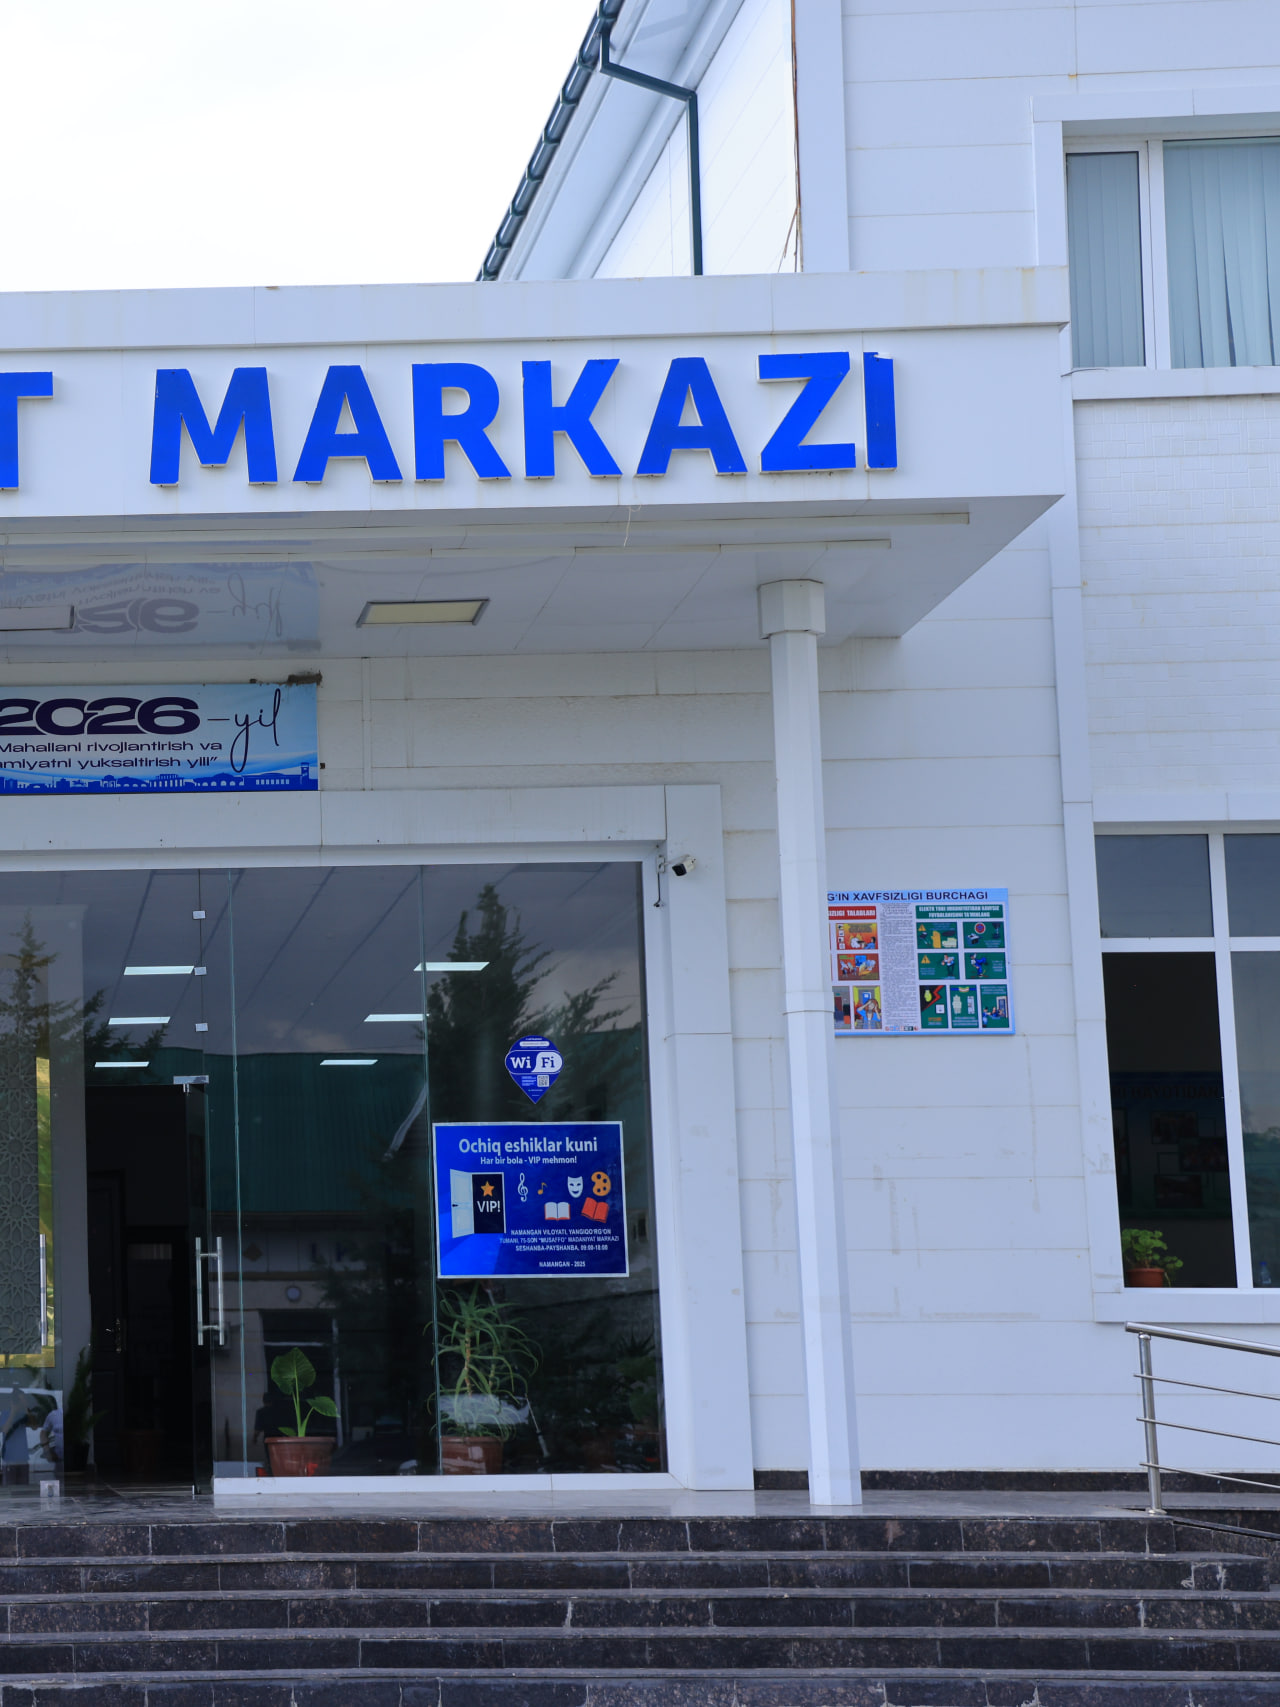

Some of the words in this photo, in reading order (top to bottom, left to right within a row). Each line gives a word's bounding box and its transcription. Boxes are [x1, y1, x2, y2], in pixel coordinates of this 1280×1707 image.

[148, 351, 898, 486] MARKAZI
[86, 740, 195, 754] rivojlantirish
[199, 741, 223, 751] va
[77, 756, 181, 770] yuksaltirish
[853, 892, 923, 901] XAVFSIZLIGI
[926, 891, 988, 900] BURCHAGI
[458, 1137, 501, 1156] Ochiq
[504, 1137, 562, 1153] eshiklar
[565, 1136, 598, 1152] kuni
[480, 1156, 492, 1165] Har
[494, 1156, 506, 1164] bir
[507, 1156, 524, 1164] bola
[528, 1156, 541, 1164] VIP
[542, 1156, 577, 1164] mehmon!
[477, 1200, 501, 1213] VIP!
[510, 1228, 542, 1236] NAMANGAN
